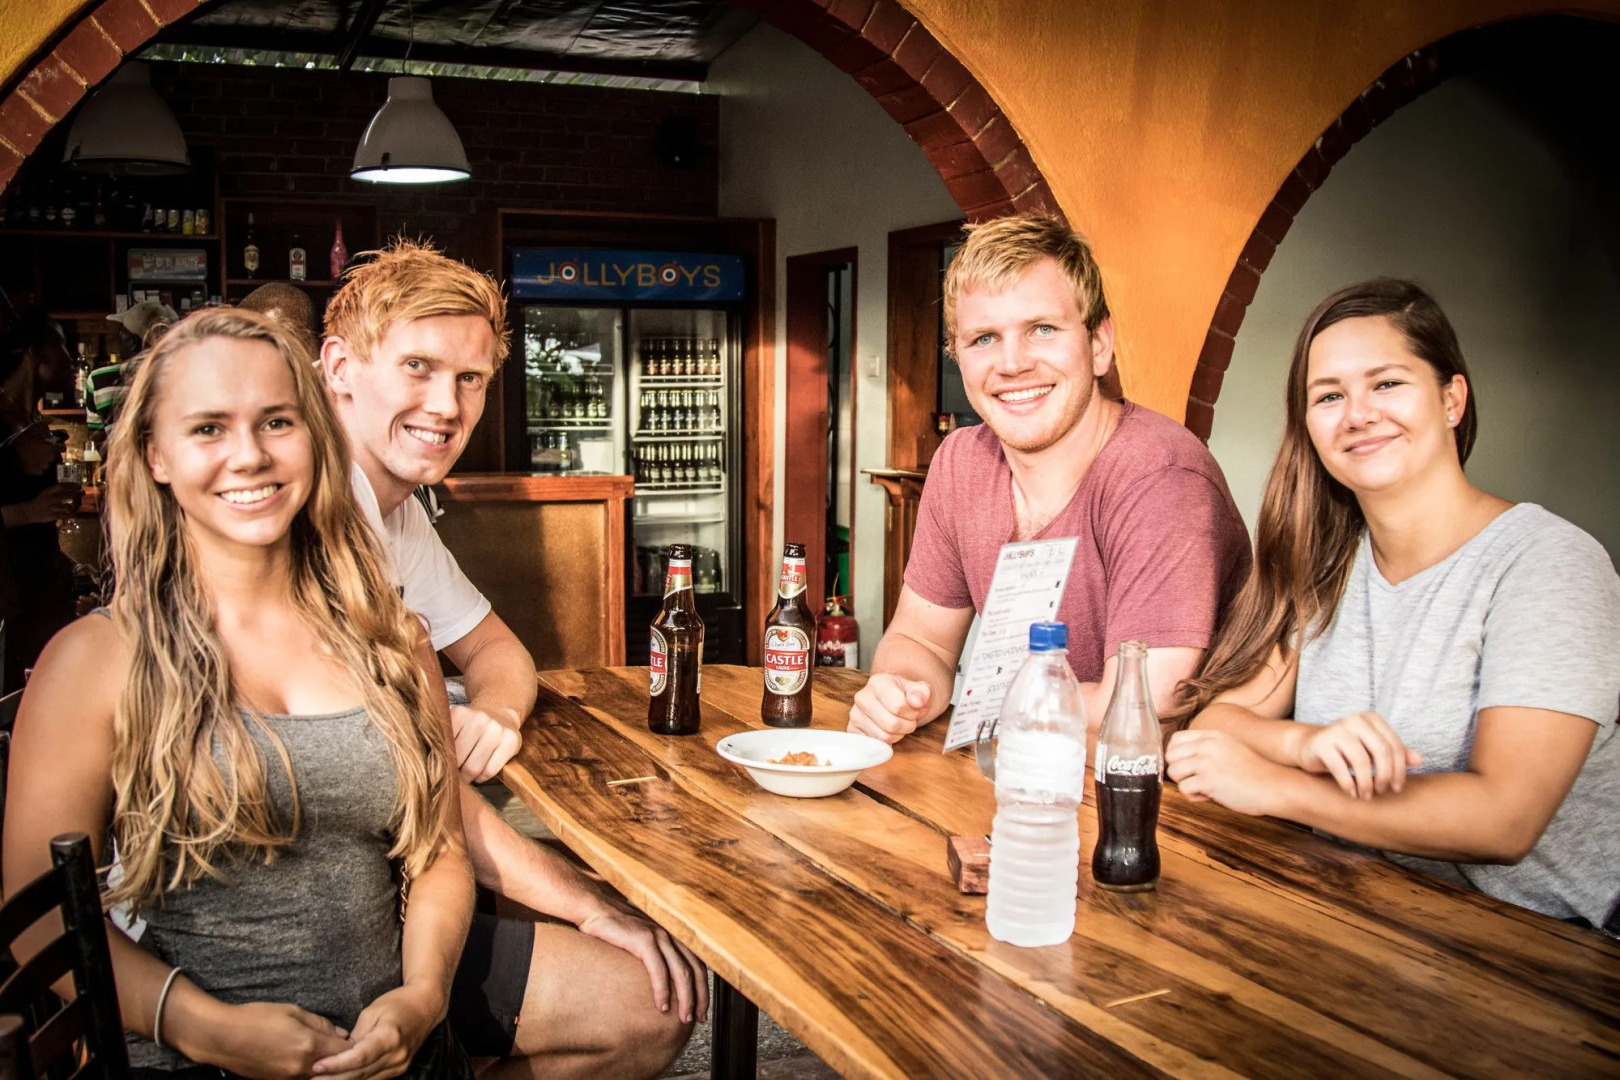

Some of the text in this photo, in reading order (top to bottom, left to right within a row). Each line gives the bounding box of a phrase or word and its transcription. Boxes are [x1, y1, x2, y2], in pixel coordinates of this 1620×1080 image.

[537, 261, 721, 288] JOLLYBOYS
[650, 656, 663, 668] TLE
[766, 653, 804, 666] CASTLE
